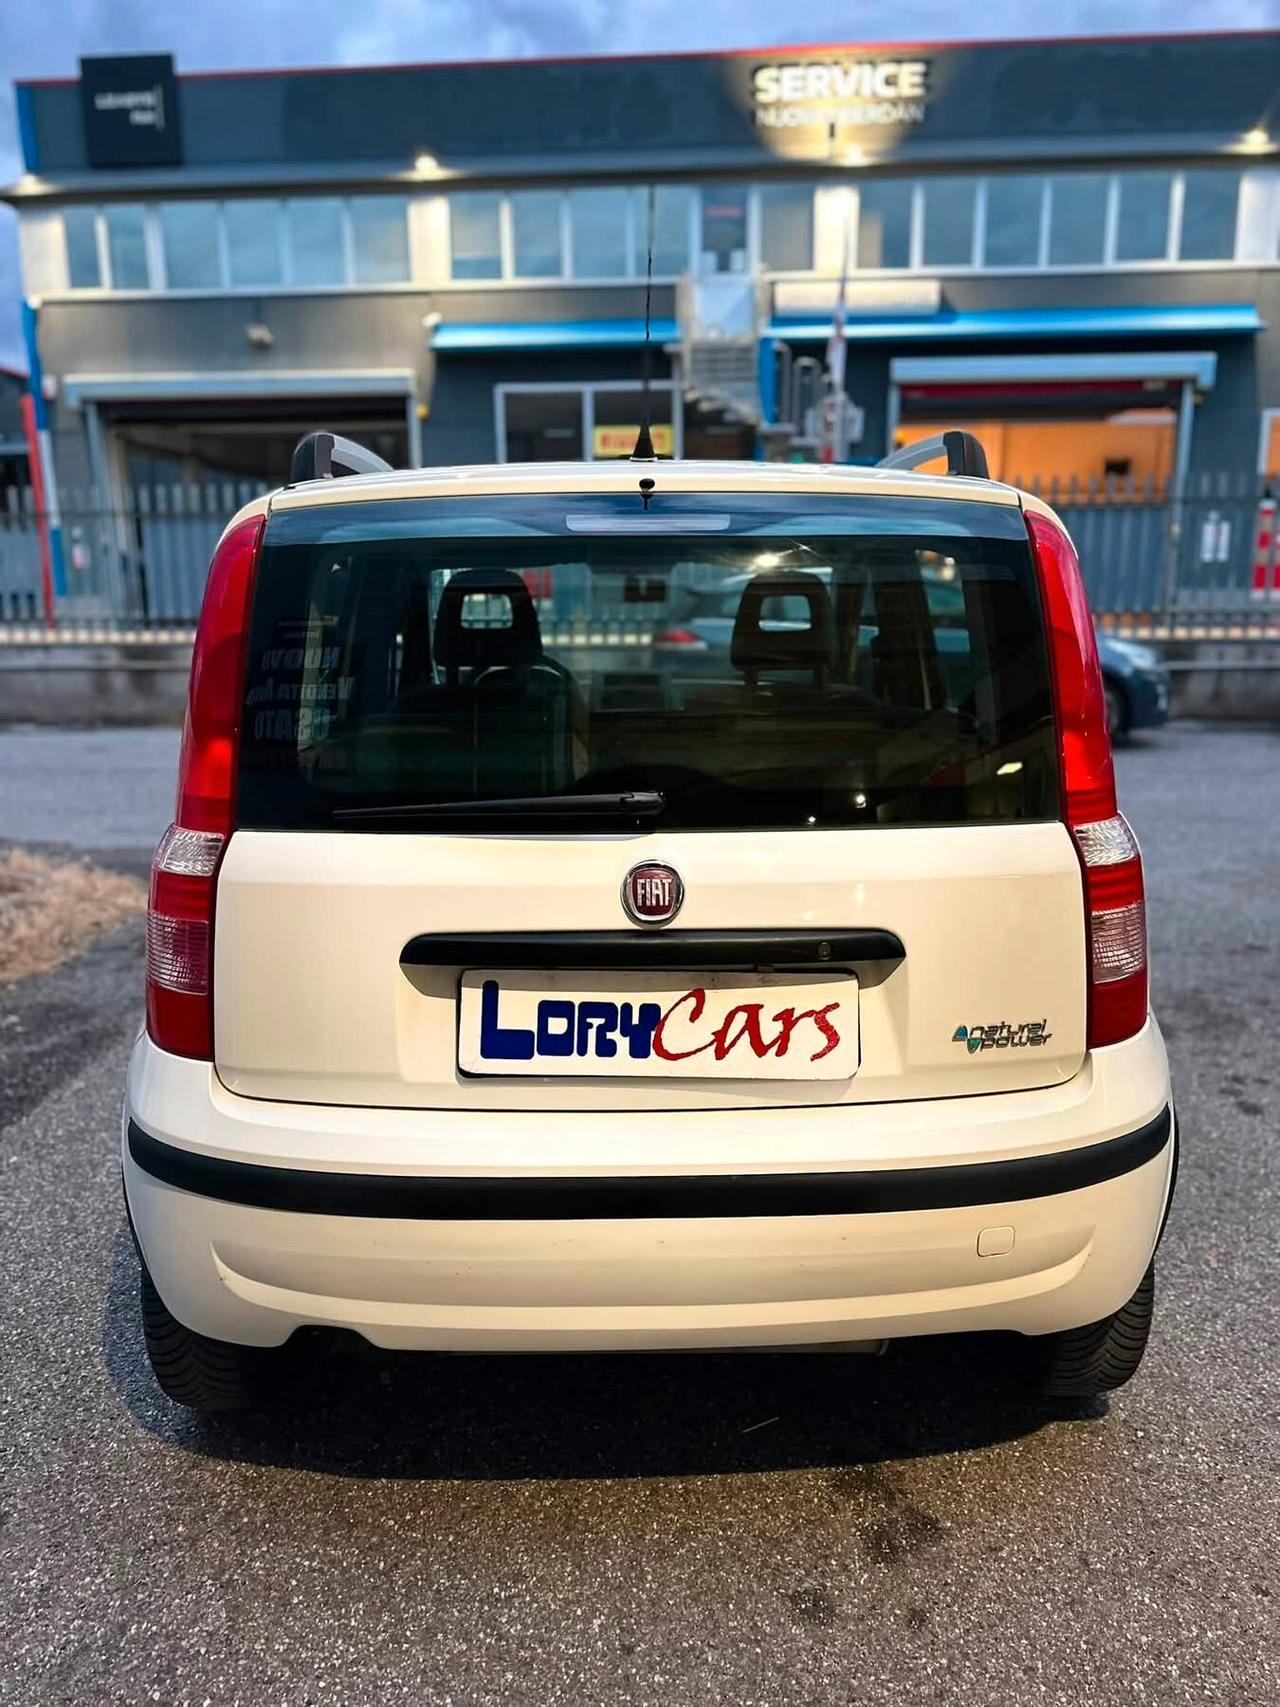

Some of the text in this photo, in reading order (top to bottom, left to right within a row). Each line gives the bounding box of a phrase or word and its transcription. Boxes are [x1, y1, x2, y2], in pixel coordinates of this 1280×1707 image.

[755, 62, 926, 103] SERVICE
[636, 878, 672, 906] FIAT
[969, 1018, 1047, 1038] natural
[980, 1033, 1053, 1052] power
